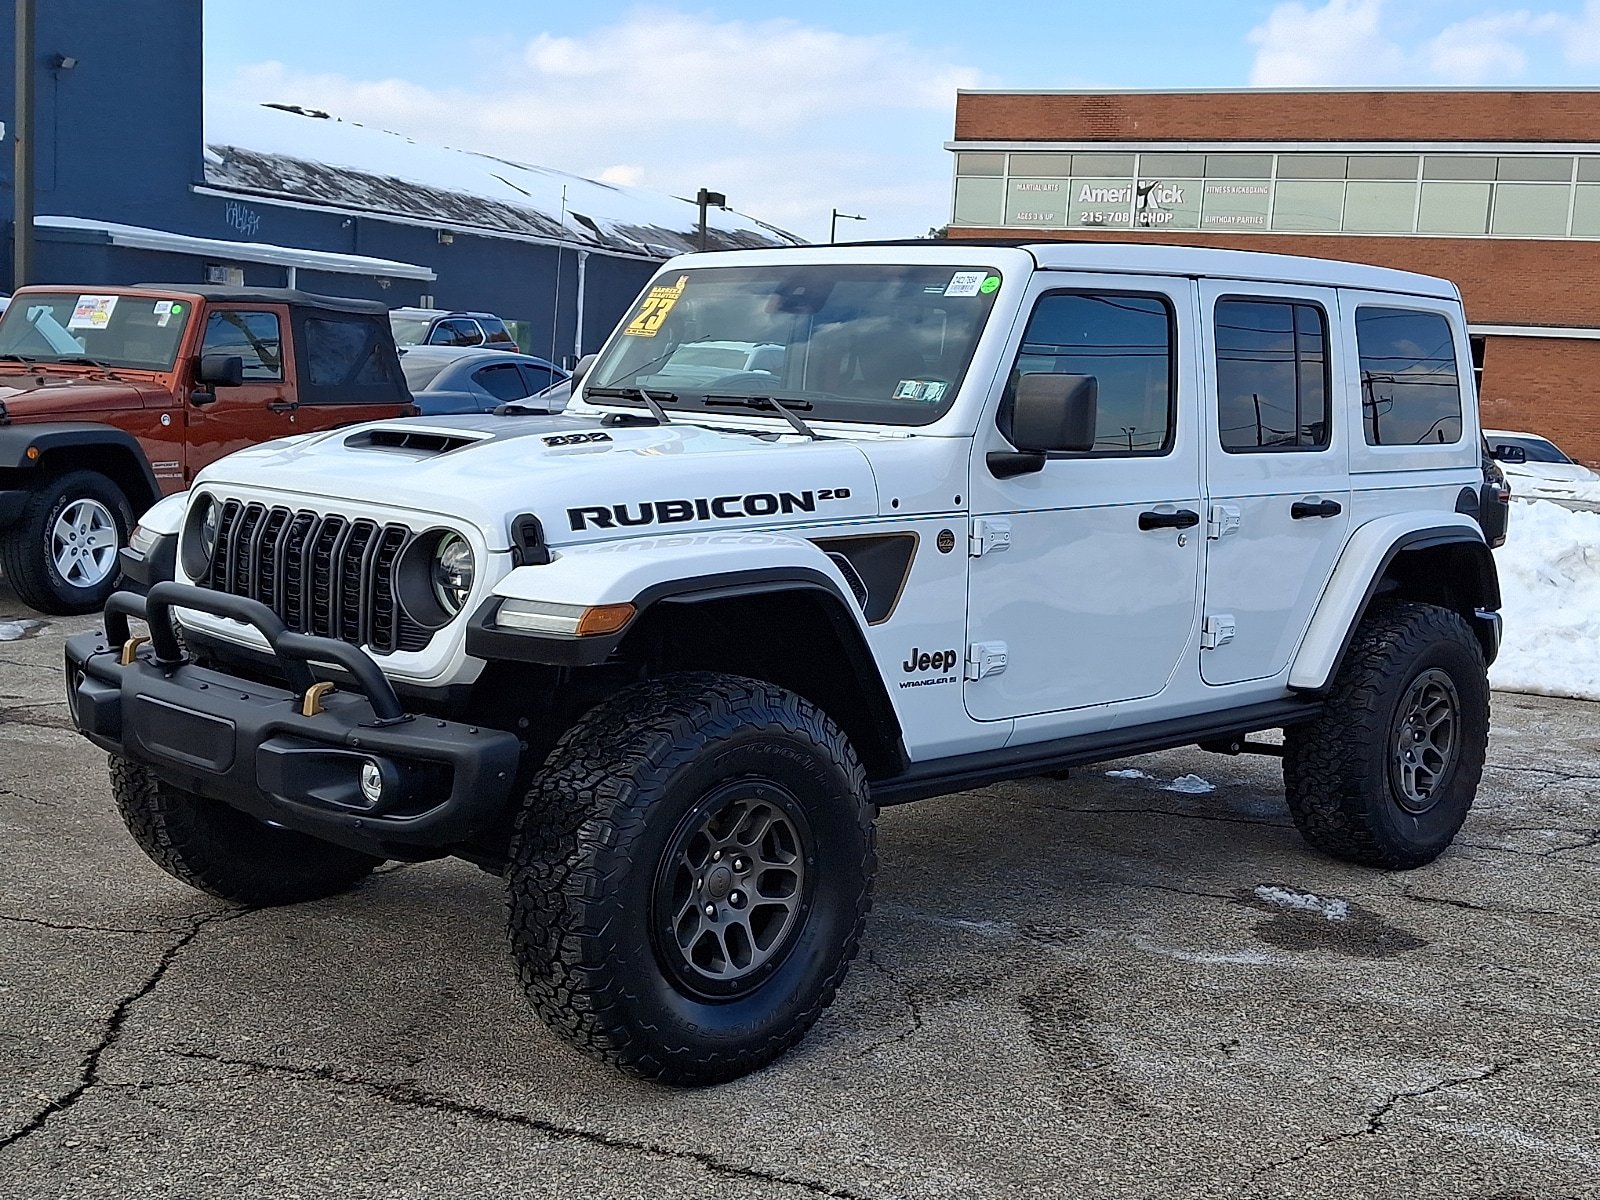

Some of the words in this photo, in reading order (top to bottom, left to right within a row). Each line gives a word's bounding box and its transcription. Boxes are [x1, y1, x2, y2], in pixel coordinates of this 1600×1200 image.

[1206, 186, 1231, 194] FITNESS
[1017, 213, 1033, 221] AGES
[1205, 215, 1236, 224] BIRTHDAY
[1237, 216, 1264, 224] PARTIES
[629, 298, 678, 331] 23
[567, 490, 816, 531] RUBICON
[902, 647, 957, 674] Jeep
[898, 677, 948, 689] WRANGLER
